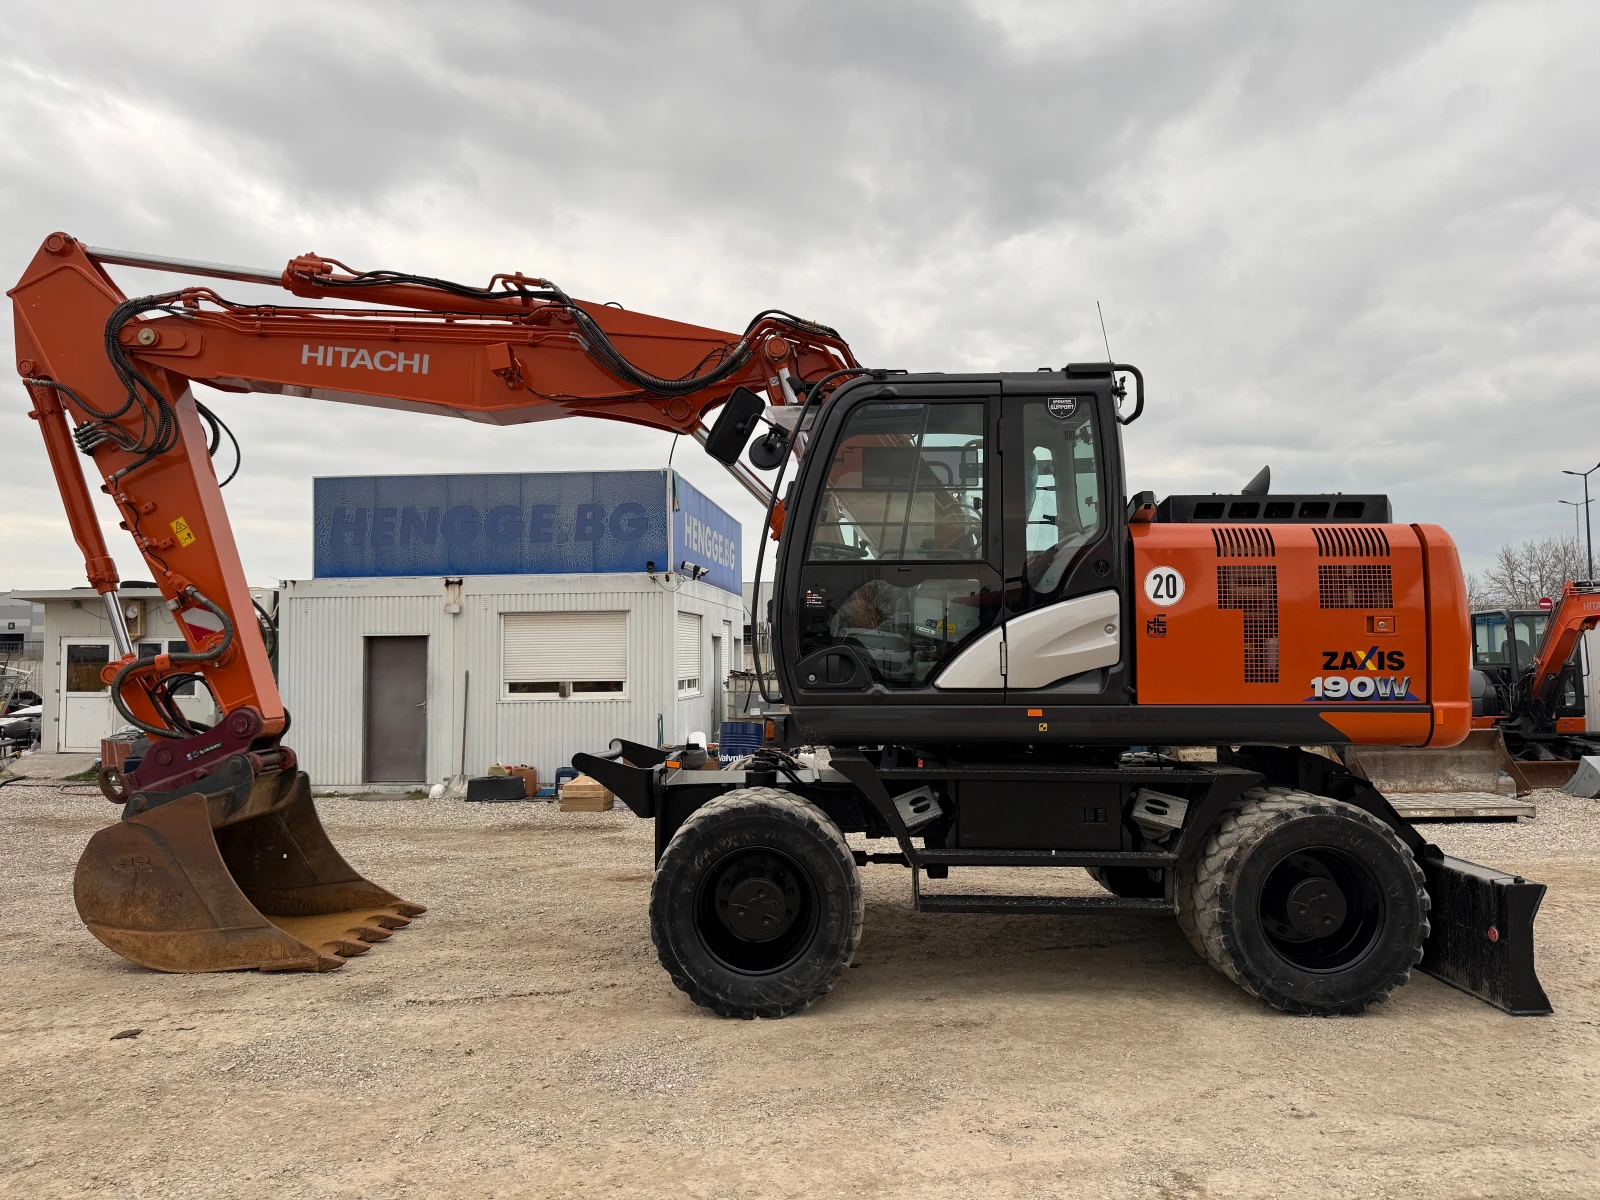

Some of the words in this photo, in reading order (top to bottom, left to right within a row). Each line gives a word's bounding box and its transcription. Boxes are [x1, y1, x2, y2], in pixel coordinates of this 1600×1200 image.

[301, 344, 430, 375] HITACHI
[329, 502, 650, 546] HENGGE.BG
[684, 511, 736, 571] HENGGE.BG
[1152, 573, 1177, 599] 20
[1322, 646, 1405, 671] ZAXIS
[1310, 676, 1412, 701] 190W
